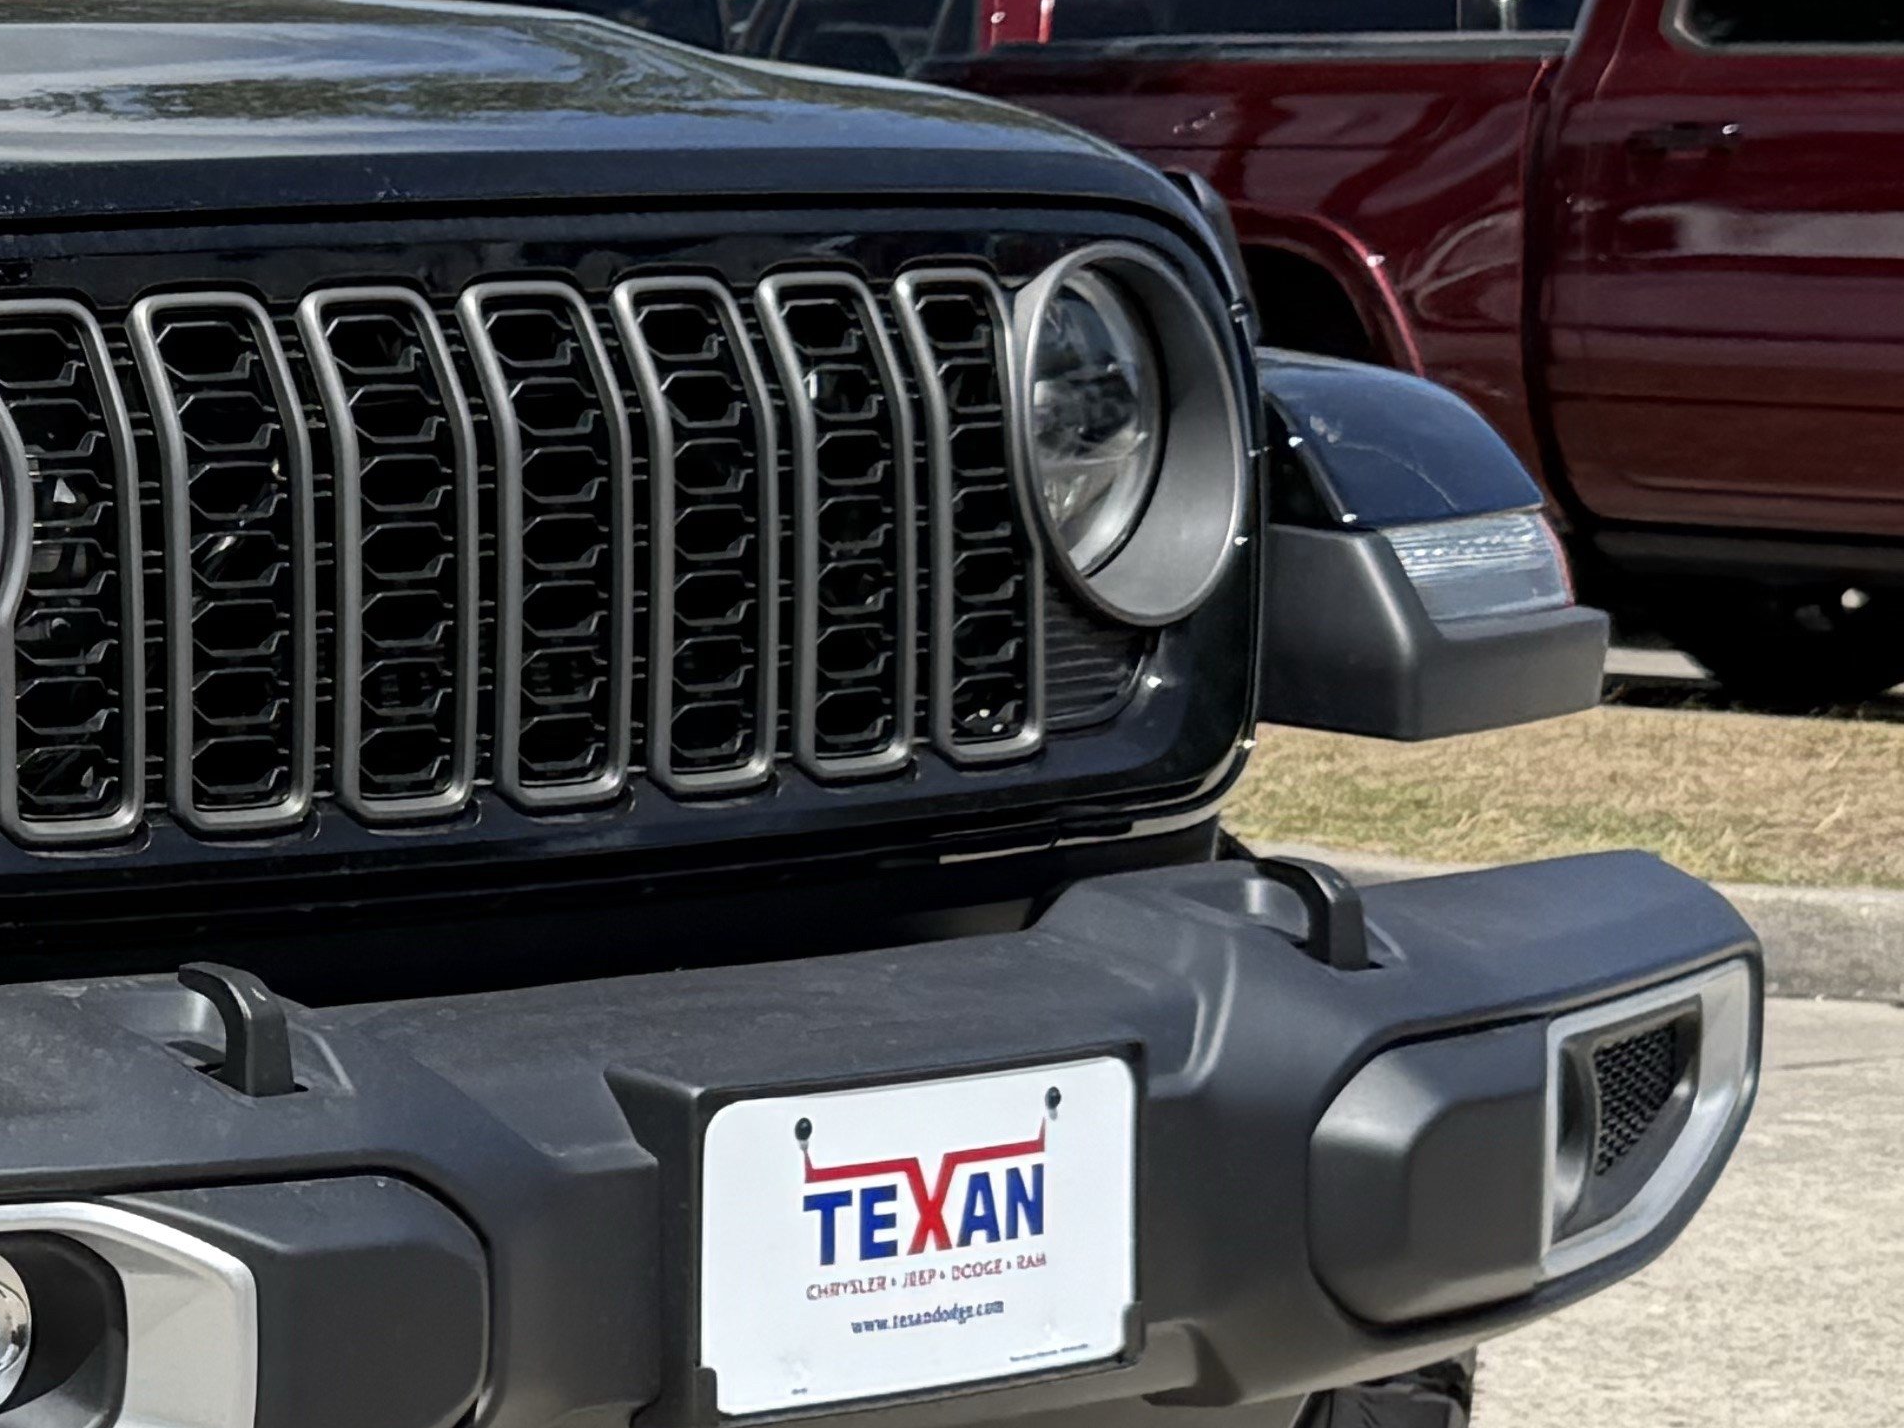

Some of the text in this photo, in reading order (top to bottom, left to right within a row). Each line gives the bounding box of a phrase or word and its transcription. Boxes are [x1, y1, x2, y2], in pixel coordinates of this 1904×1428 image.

[802, 1128, 1047, 1265] TEXAN
[806, 1253, 1047, 1300] CHRYSLER JEEP DODGE RAM
[851, 1300, 1004, 1334] www.texandodge.com
